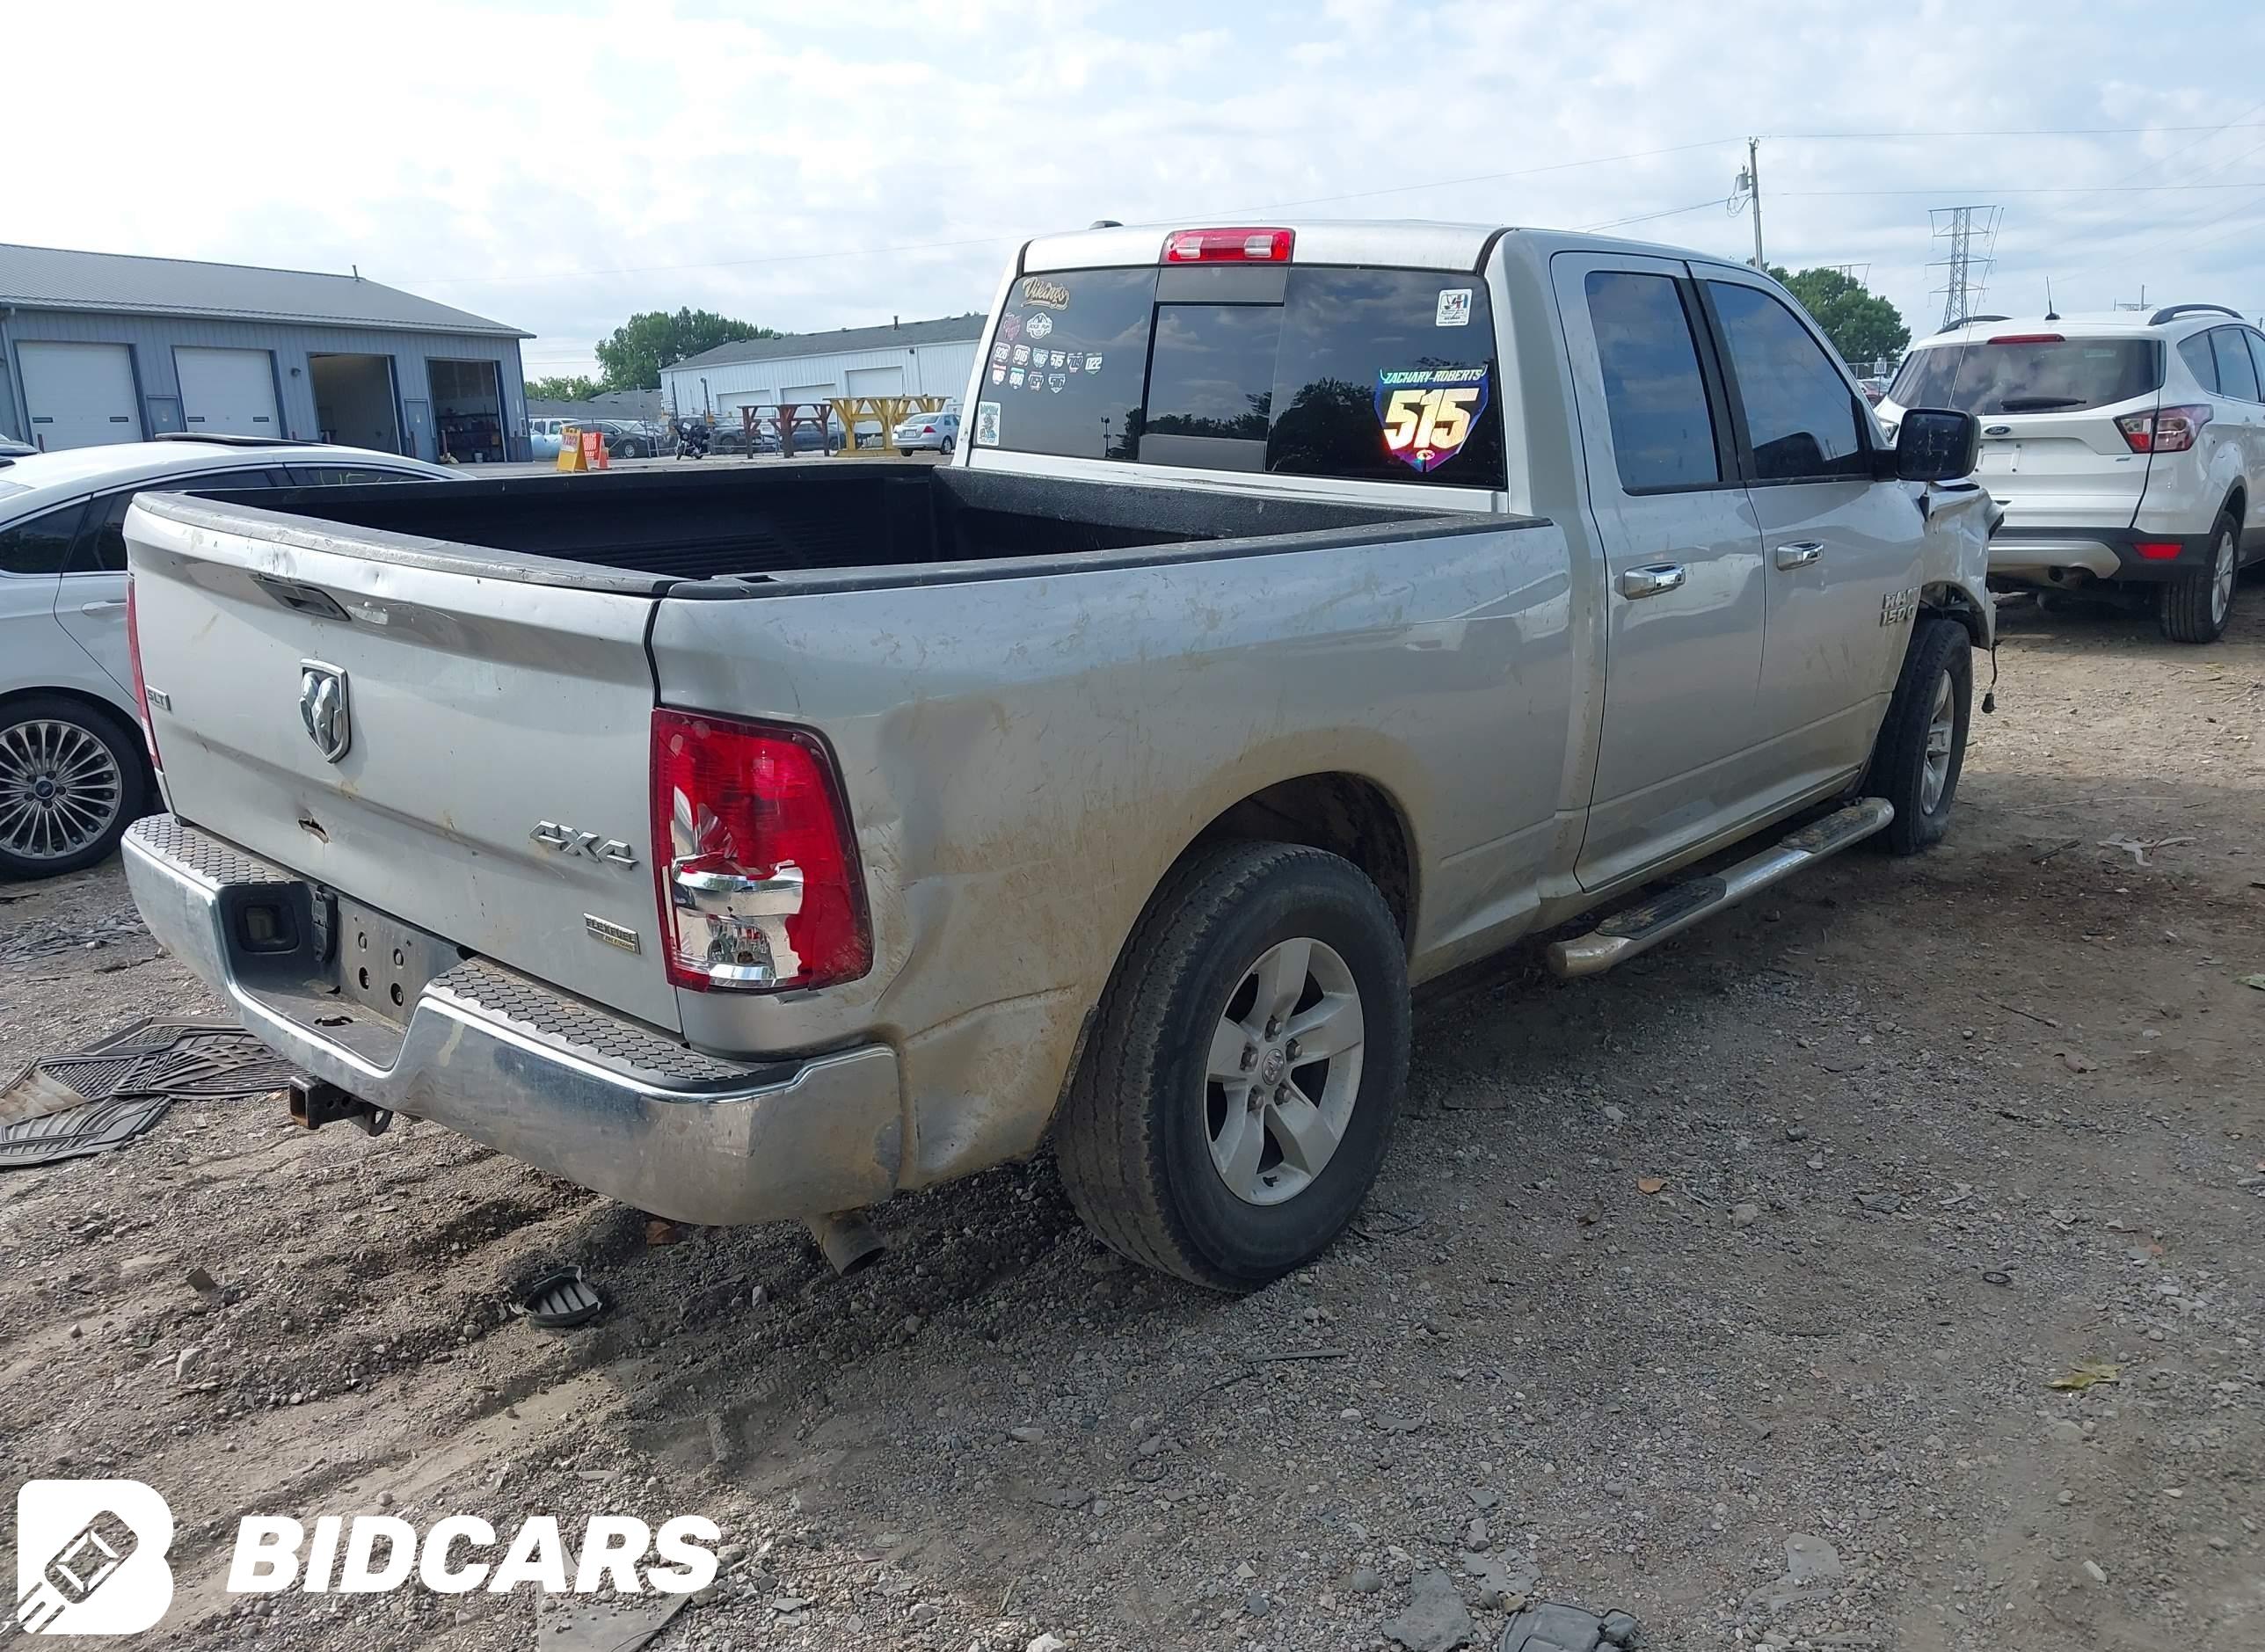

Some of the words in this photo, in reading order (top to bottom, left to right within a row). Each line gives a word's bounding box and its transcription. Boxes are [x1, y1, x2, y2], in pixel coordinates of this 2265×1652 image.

[1383, 388, 1479, 449] 515
[1880, 604, 1915, 628] 1500
[148, 689, 164, 706] SLT
